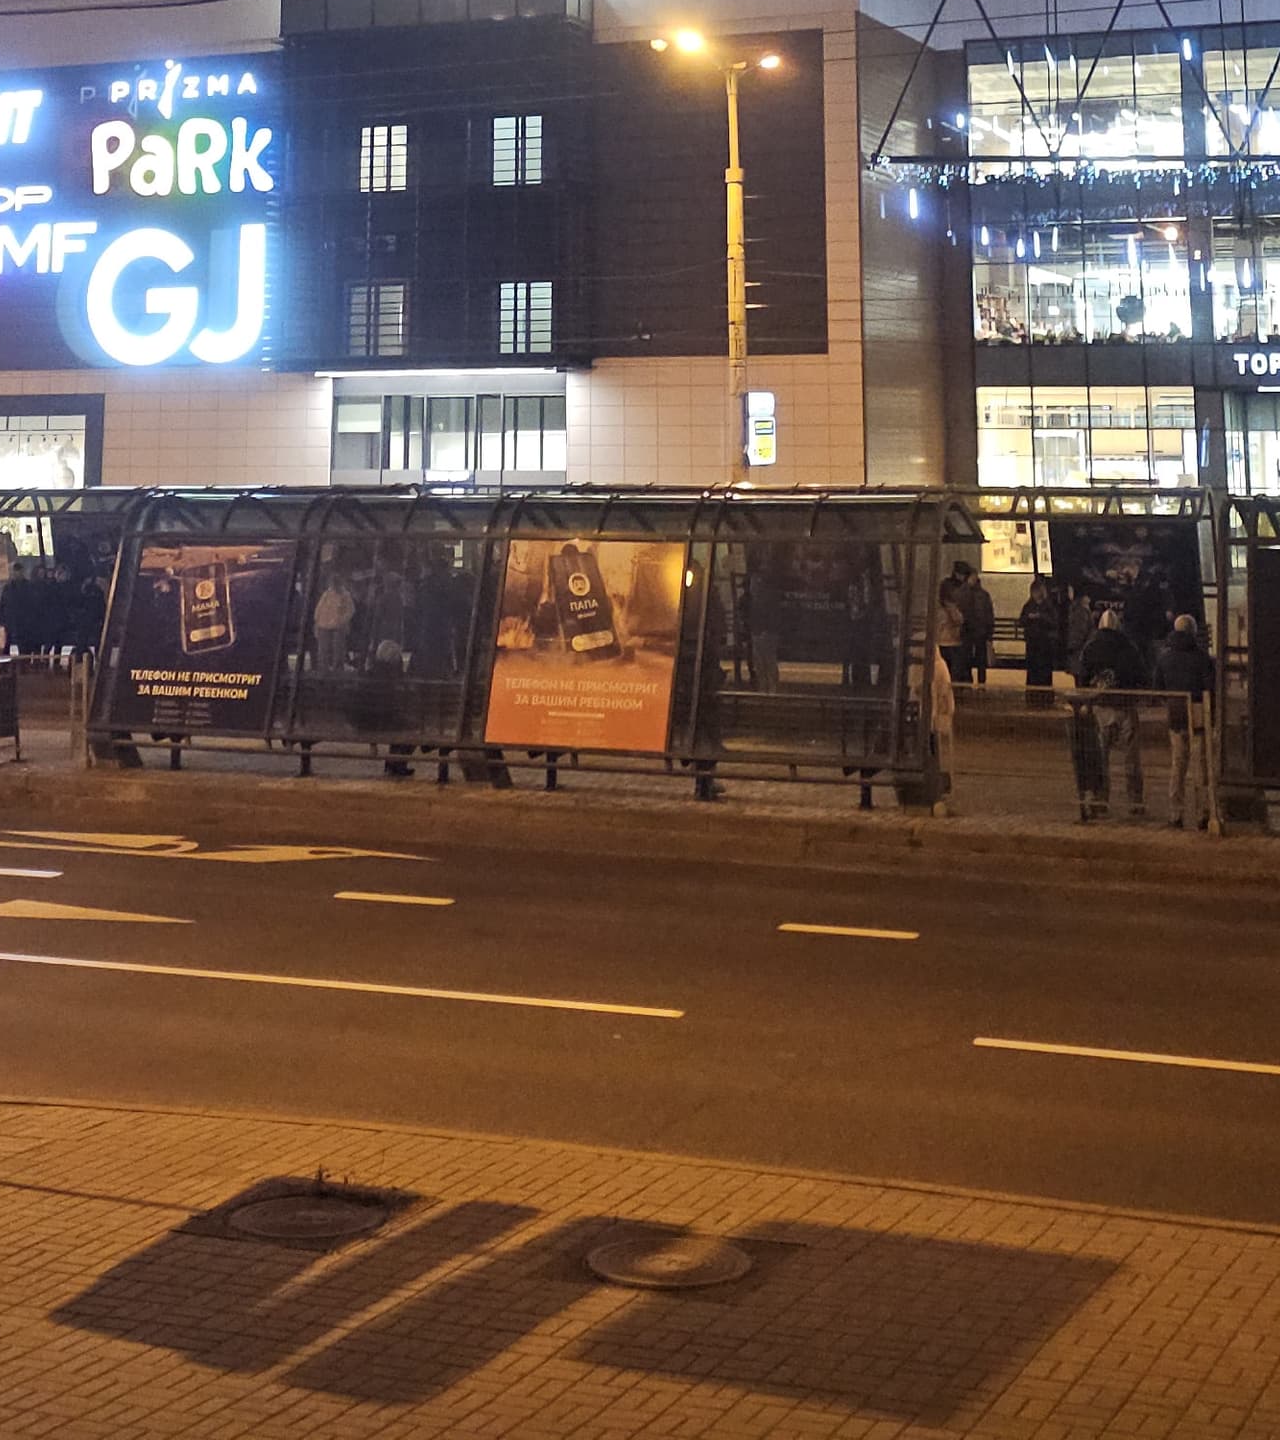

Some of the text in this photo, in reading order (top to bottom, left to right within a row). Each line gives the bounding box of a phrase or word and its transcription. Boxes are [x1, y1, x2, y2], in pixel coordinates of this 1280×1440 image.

[87, 223, 266, 366] GJ
[570, 599, 599, 612] ПАПА
[131, 669, 262, 685] ТЕЛЕФОН НЕ ПРИСМОТРИТ
[137, 685, 150, 695] ЗА
[152, 685, 191, 697] ВАШИМ
[514, 695, 529, 705] ЗА
[532, 696, 577, 707] ВАШИМ
